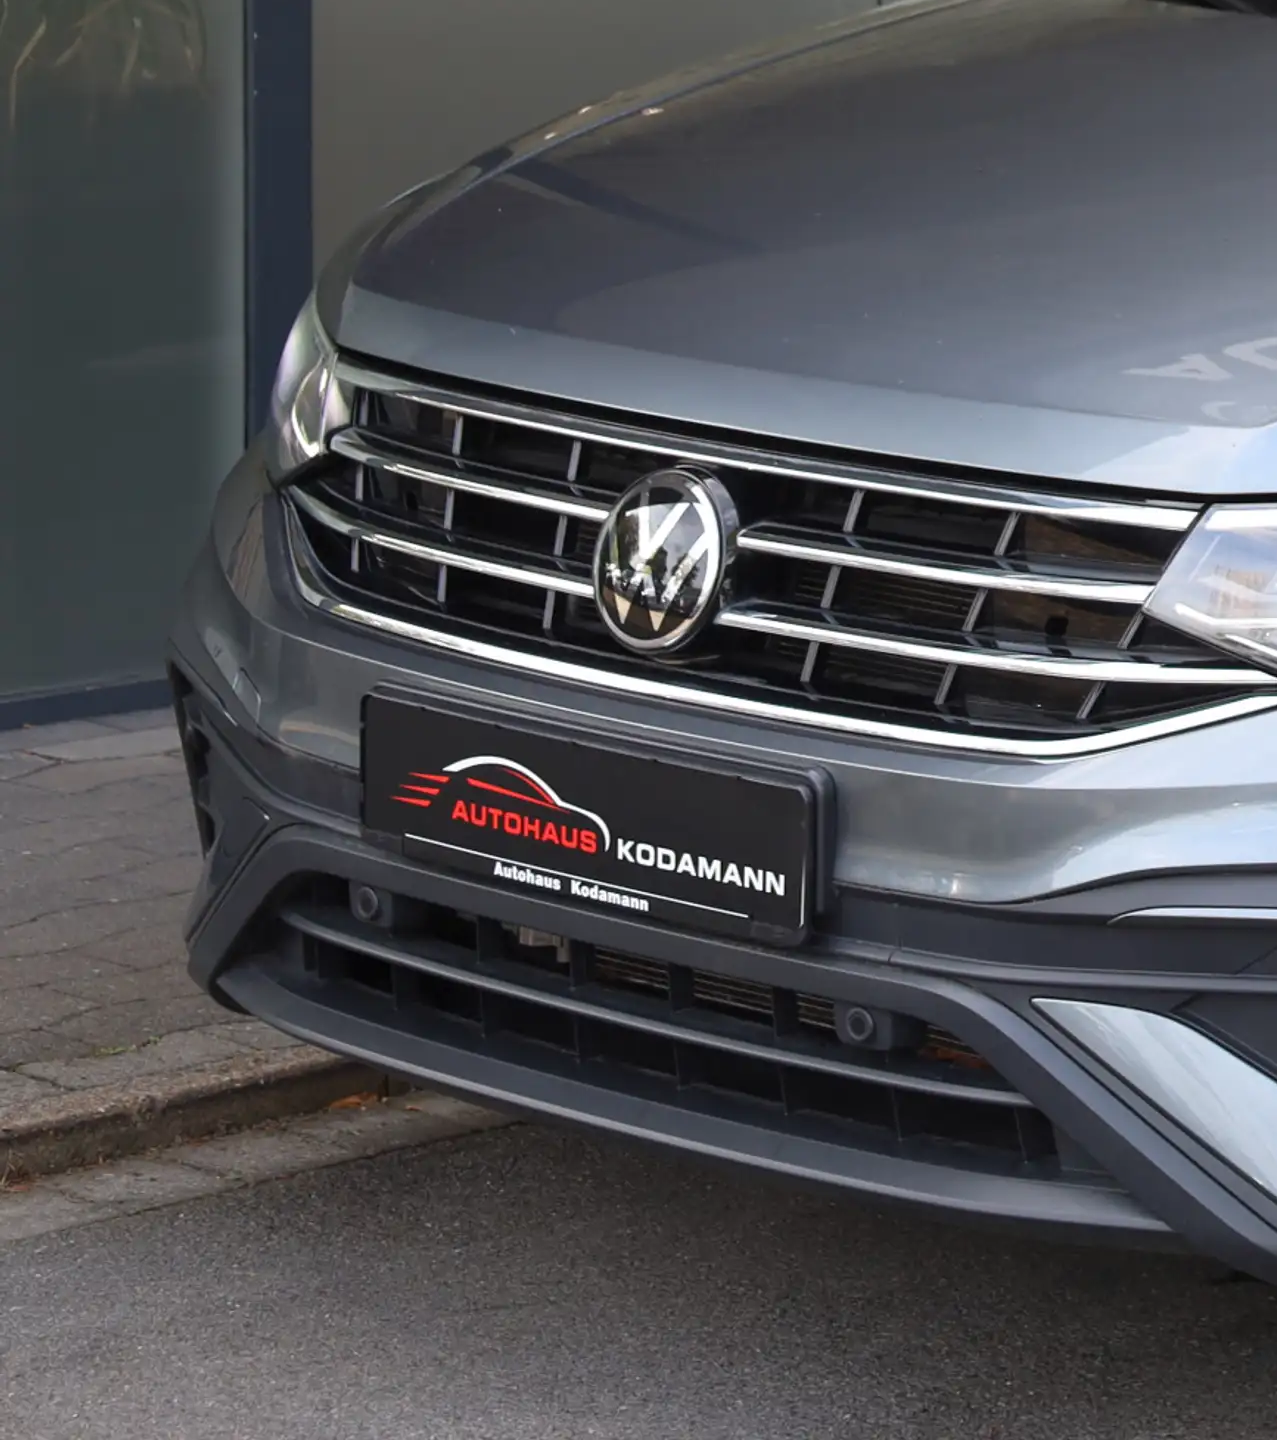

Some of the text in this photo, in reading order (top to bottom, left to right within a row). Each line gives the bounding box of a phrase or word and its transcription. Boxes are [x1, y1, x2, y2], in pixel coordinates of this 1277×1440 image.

[451, 799, 787, 897] AUTOHAUS KODAMANN
[493, 861, 650, 913] Autohaus Kodamann
